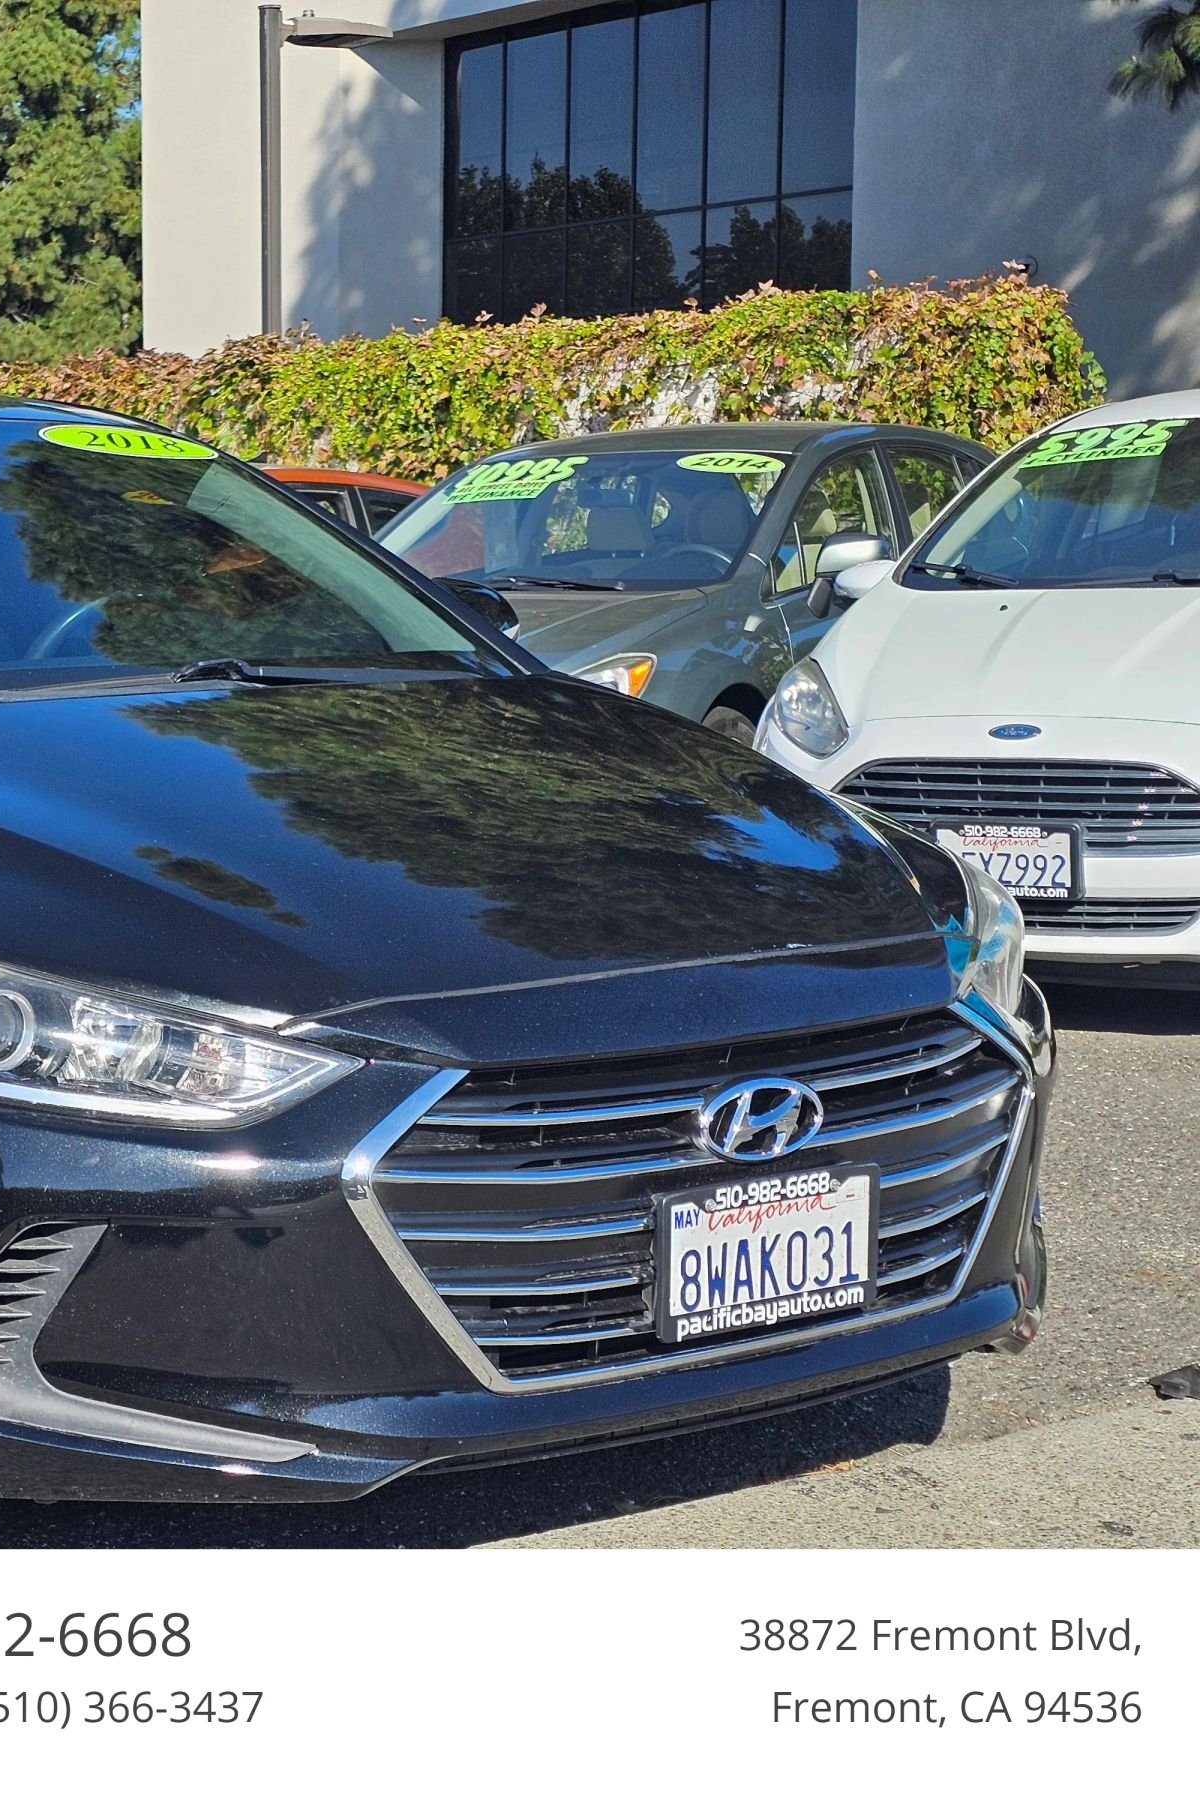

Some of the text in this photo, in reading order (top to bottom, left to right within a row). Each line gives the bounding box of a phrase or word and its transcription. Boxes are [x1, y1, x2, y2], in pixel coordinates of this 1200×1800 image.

[77, 430, 185, 453] 2018
[1030, 420, 1189, 459] 5995
[454, 456, 589, 488] 10995
[689, 457, 772, 469] 2014
[471, 489, 539, 499] FINANCE
[962, 837, 1048, 852] California
[963, 824, 1042, 838] 510-982-6668
[962, 852, 1067, 887] XZ992
[1006, 885, 1068, 899] auto.com
[714, 1171, 831, 1211] 510-982-6668
[674, 1208, 701, 1230] MAY
[707, 1195, 836, 1234] California
[679, 1220, 860, 1313] 8WAK031
[676, 1286, 865, 1343] pacificbayauto.com
